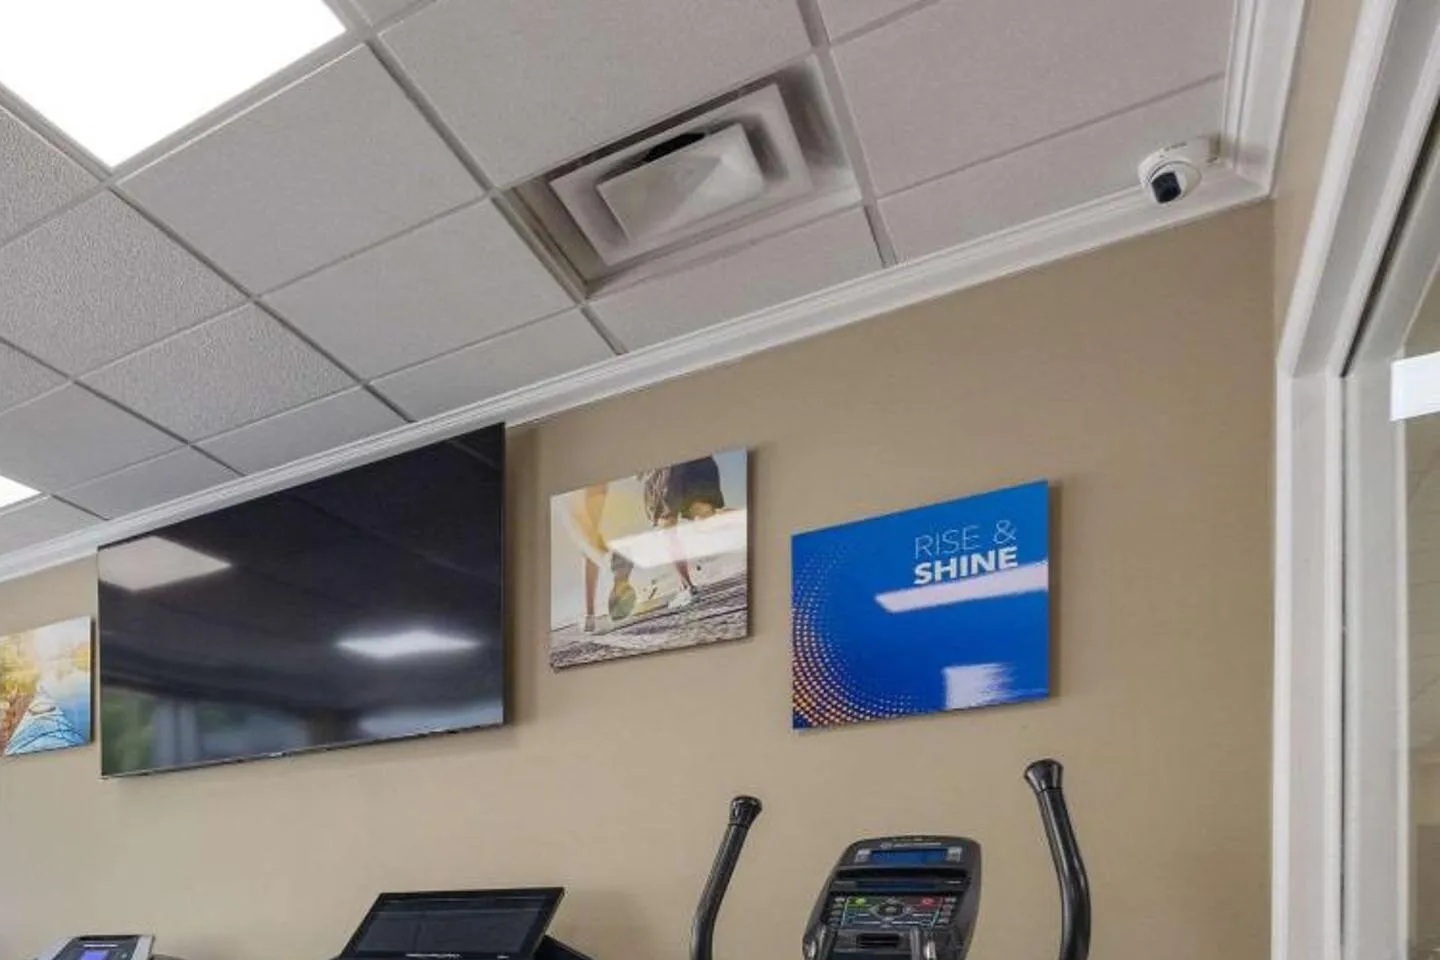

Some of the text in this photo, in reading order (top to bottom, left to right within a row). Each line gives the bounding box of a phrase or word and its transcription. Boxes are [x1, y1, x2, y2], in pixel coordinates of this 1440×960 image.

[915, 519, 1017, 560] RISE &
[913, 545, 1018, 584] SHINE
